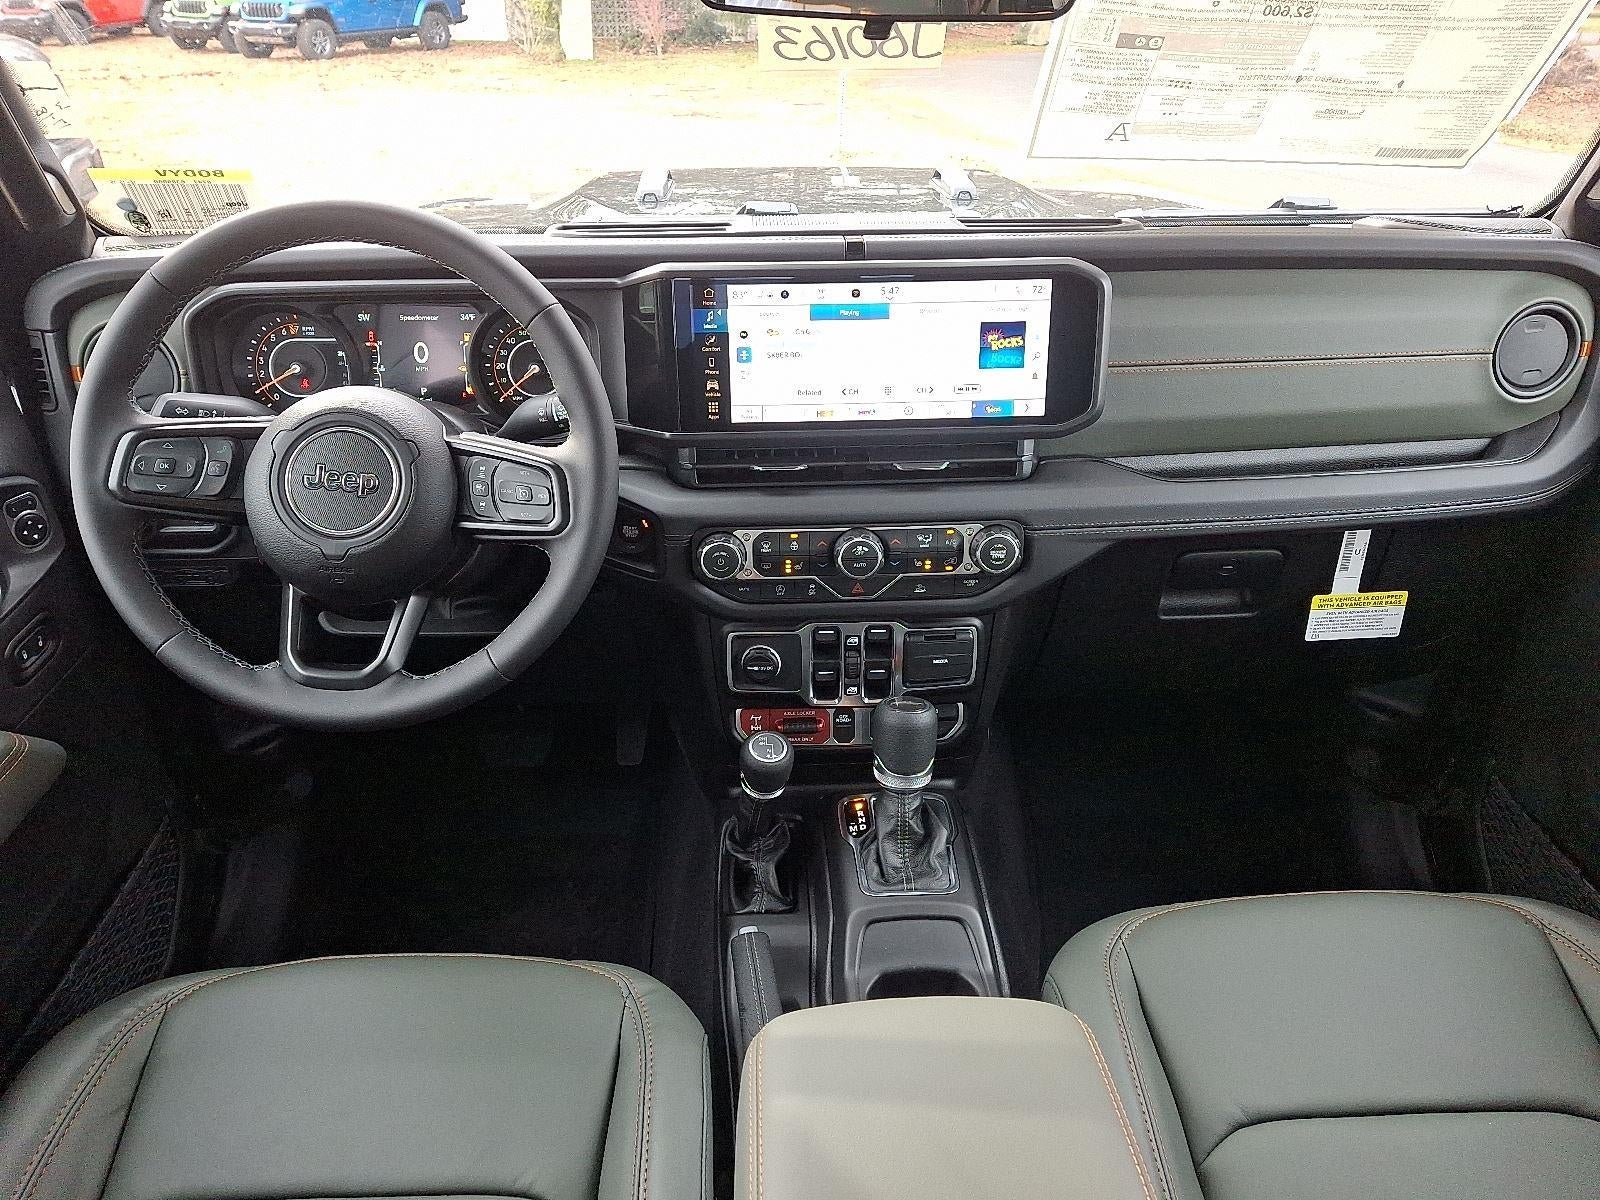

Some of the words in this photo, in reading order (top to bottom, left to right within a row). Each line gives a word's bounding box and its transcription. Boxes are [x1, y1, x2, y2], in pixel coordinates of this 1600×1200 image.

[840, 309, 861, 317] Playing
[357, 313, 371, 322] SW
[399, 314, 440, 322] Speedometer
[281, 328, 287, 336] 6
[270, 334, 276, 342] 5
[261, 344, 268, 352] 4
[412, 341, 430, 364] 0
[258, 356, 264, 364] 3
[495, 362, 506, 370] 20
[260, 370, 266, 378] 2
[273, 393, 280, 401] 0
[302, 462, 379, 498] Jeep
[849, 824, 858, 833] M
